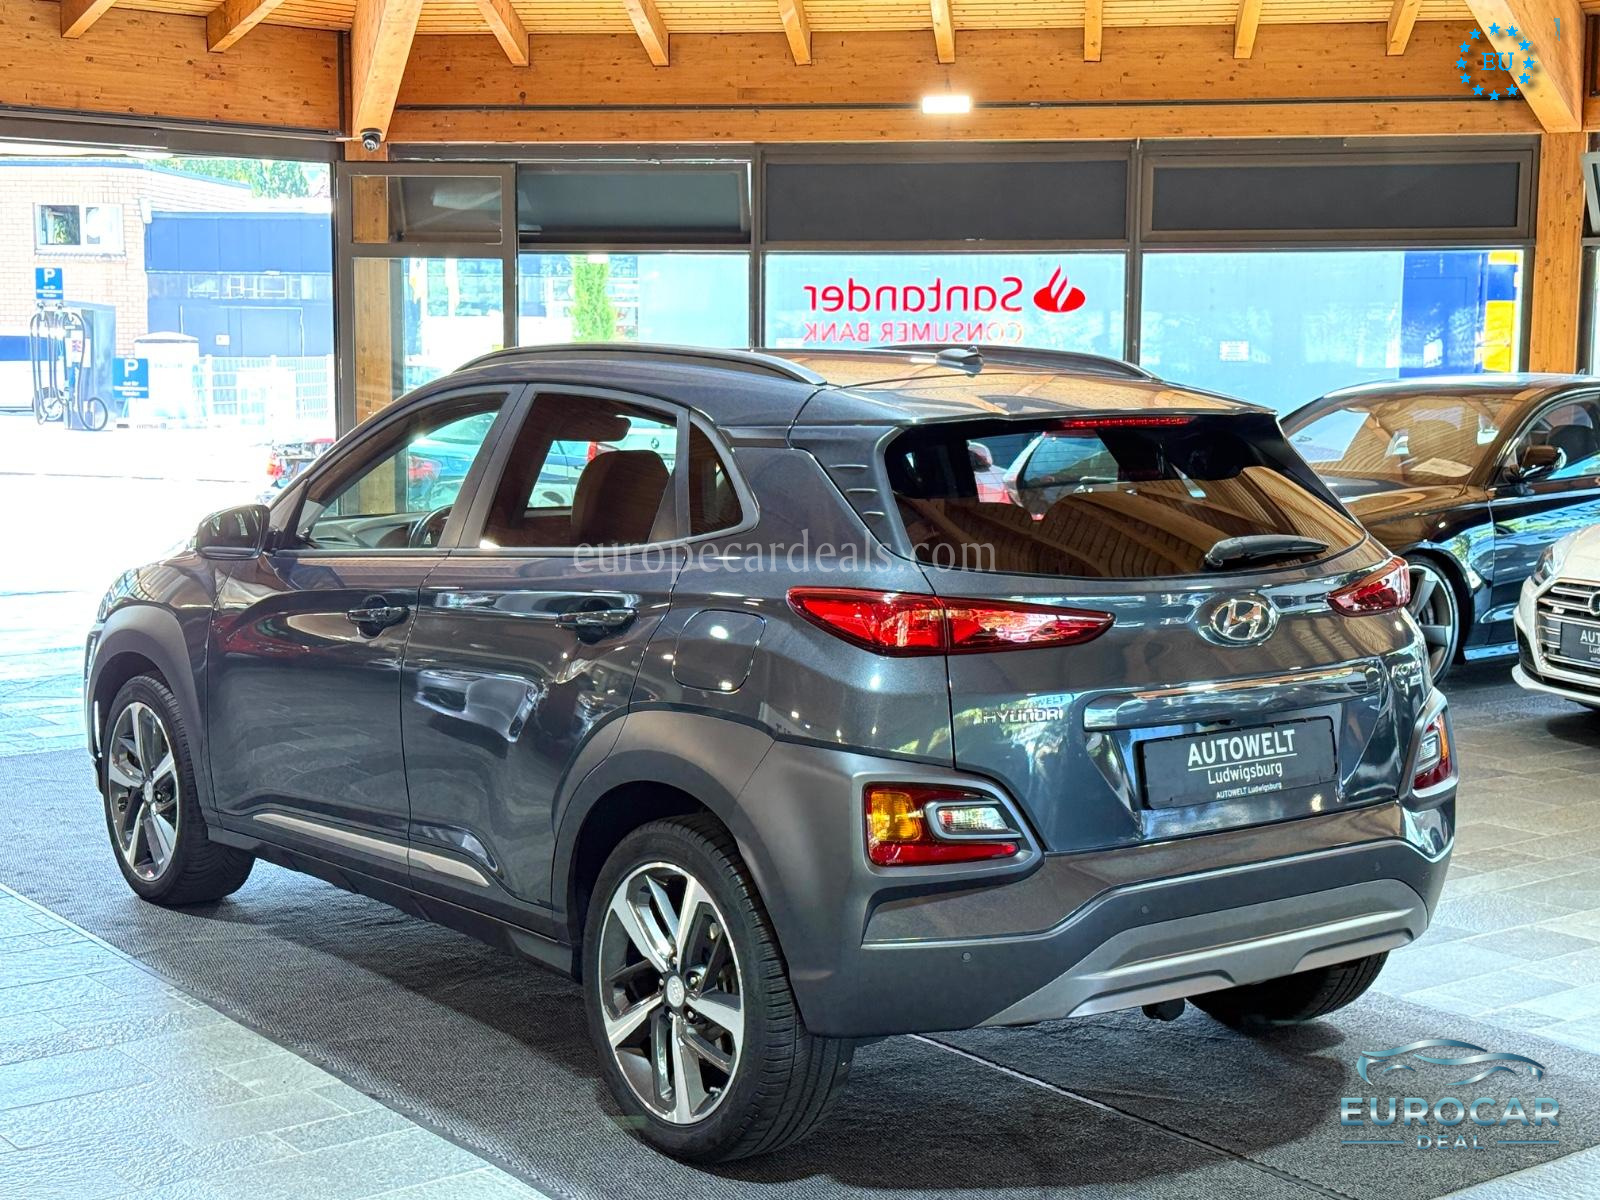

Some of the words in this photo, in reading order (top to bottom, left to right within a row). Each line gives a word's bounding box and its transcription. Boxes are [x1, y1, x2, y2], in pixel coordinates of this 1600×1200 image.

[44, 268, 56, 283] P
[124, 359, 139, 378] P
[1187, 729, 1296, 767] AUTOWELT
[1207, 762, 1284, 785] Ludwigsburg
[1216, 786, 1247, 800] AUTOWELT
[1247, 782, 1282, 795] Ludwigsburg
